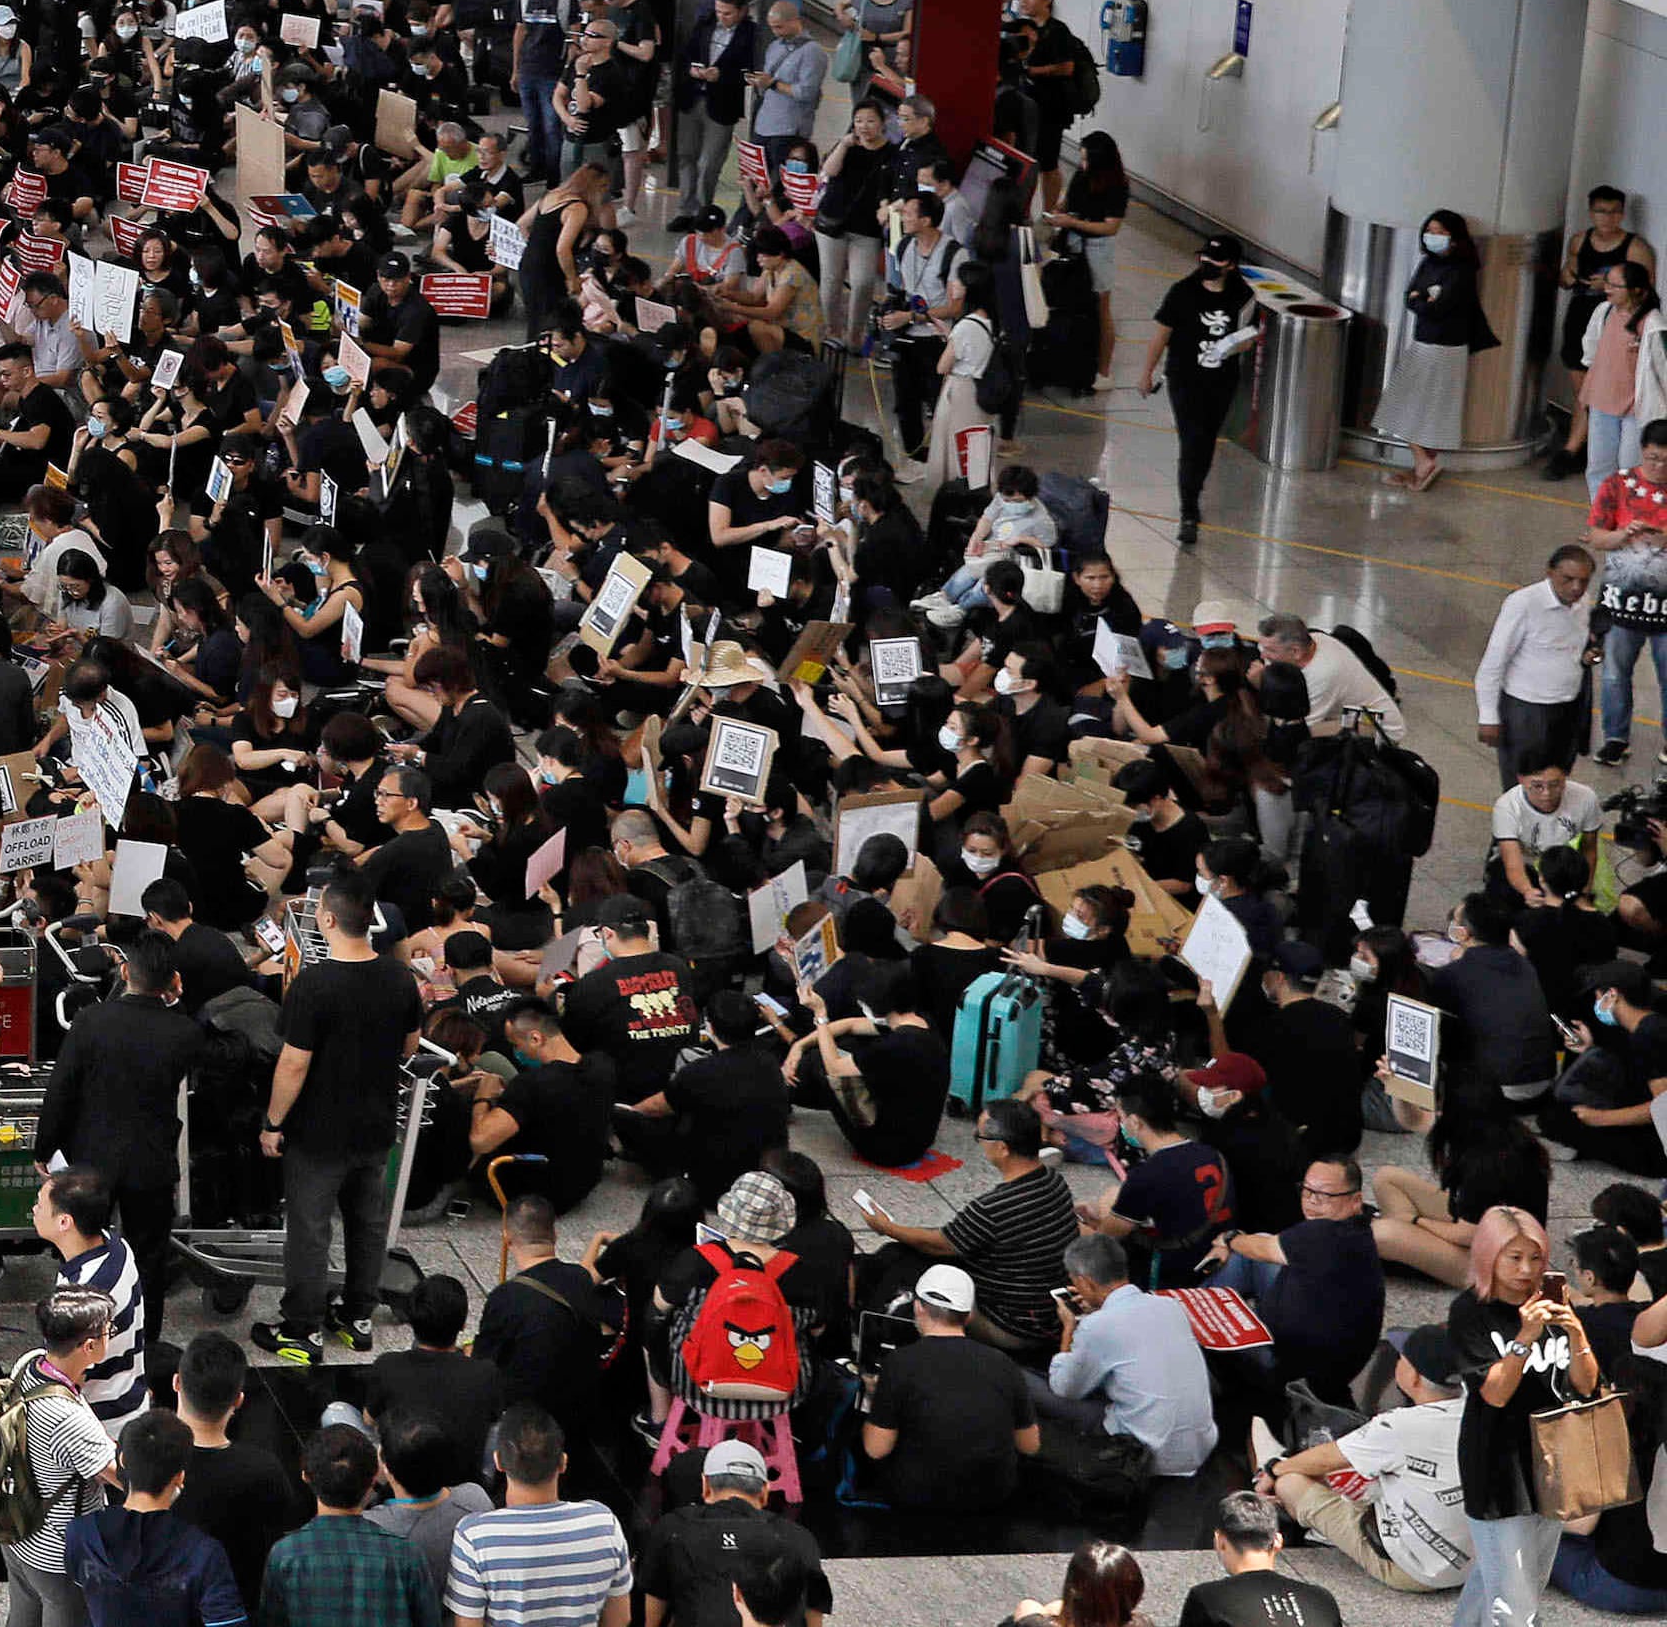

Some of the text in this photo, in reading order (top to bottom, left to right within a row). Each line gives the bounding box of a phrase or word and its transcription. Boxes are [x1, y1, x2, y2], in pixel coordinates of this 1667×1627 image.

[4, 835, 51, 854] OFFLOAD
[7, 852, 43, 869] CARRIE
[628, 1029, 651, 1040] THE
